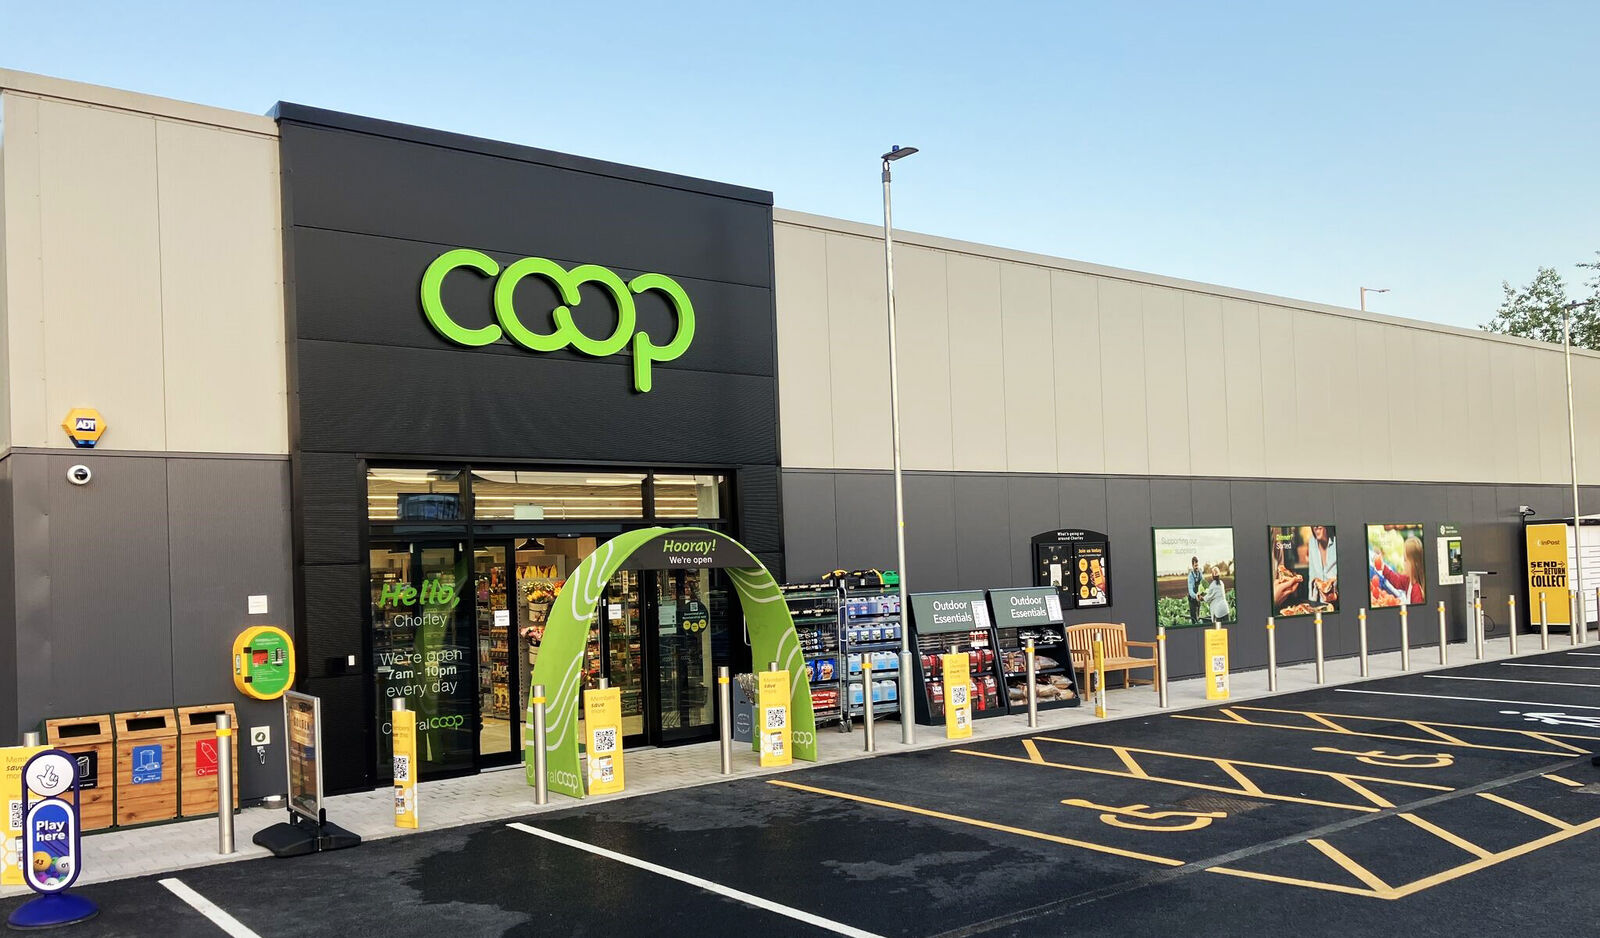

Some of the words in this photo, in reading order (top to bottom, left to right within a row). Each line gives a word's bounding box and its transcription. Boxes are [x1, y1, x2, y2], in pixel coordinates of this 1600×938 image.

[421, 249, 695, 392] coop
[76, 419, 96, 430] ADT
[663, 539, 716, 555] Hooray!
[669, 556, 691, 564] We're
[693, 557, 712, 565] open
[1531, 575, 1566, 587] COLLECT
[380, 579, 460, 608] Hello,
[933, 600, 967, 611] Outdoor
[1010, 597, 1042, 606] Outdoor
[933, 613, 972, 624] Essentials
[1011, 608, 1047, 619] Essentials
[394, 613, 447, 628] Chorley
[380, 651, 422, 666] We're
[426, 649, 463, 664] open
[388, 669, 414, 680] 7am
[425, 665, 457, 678] 10pm
[386, 684, 427, 698] every
[432, 679, 458, 695] day
[36, 820, 65, 832] Play
[36, 832, 65, 842] here
